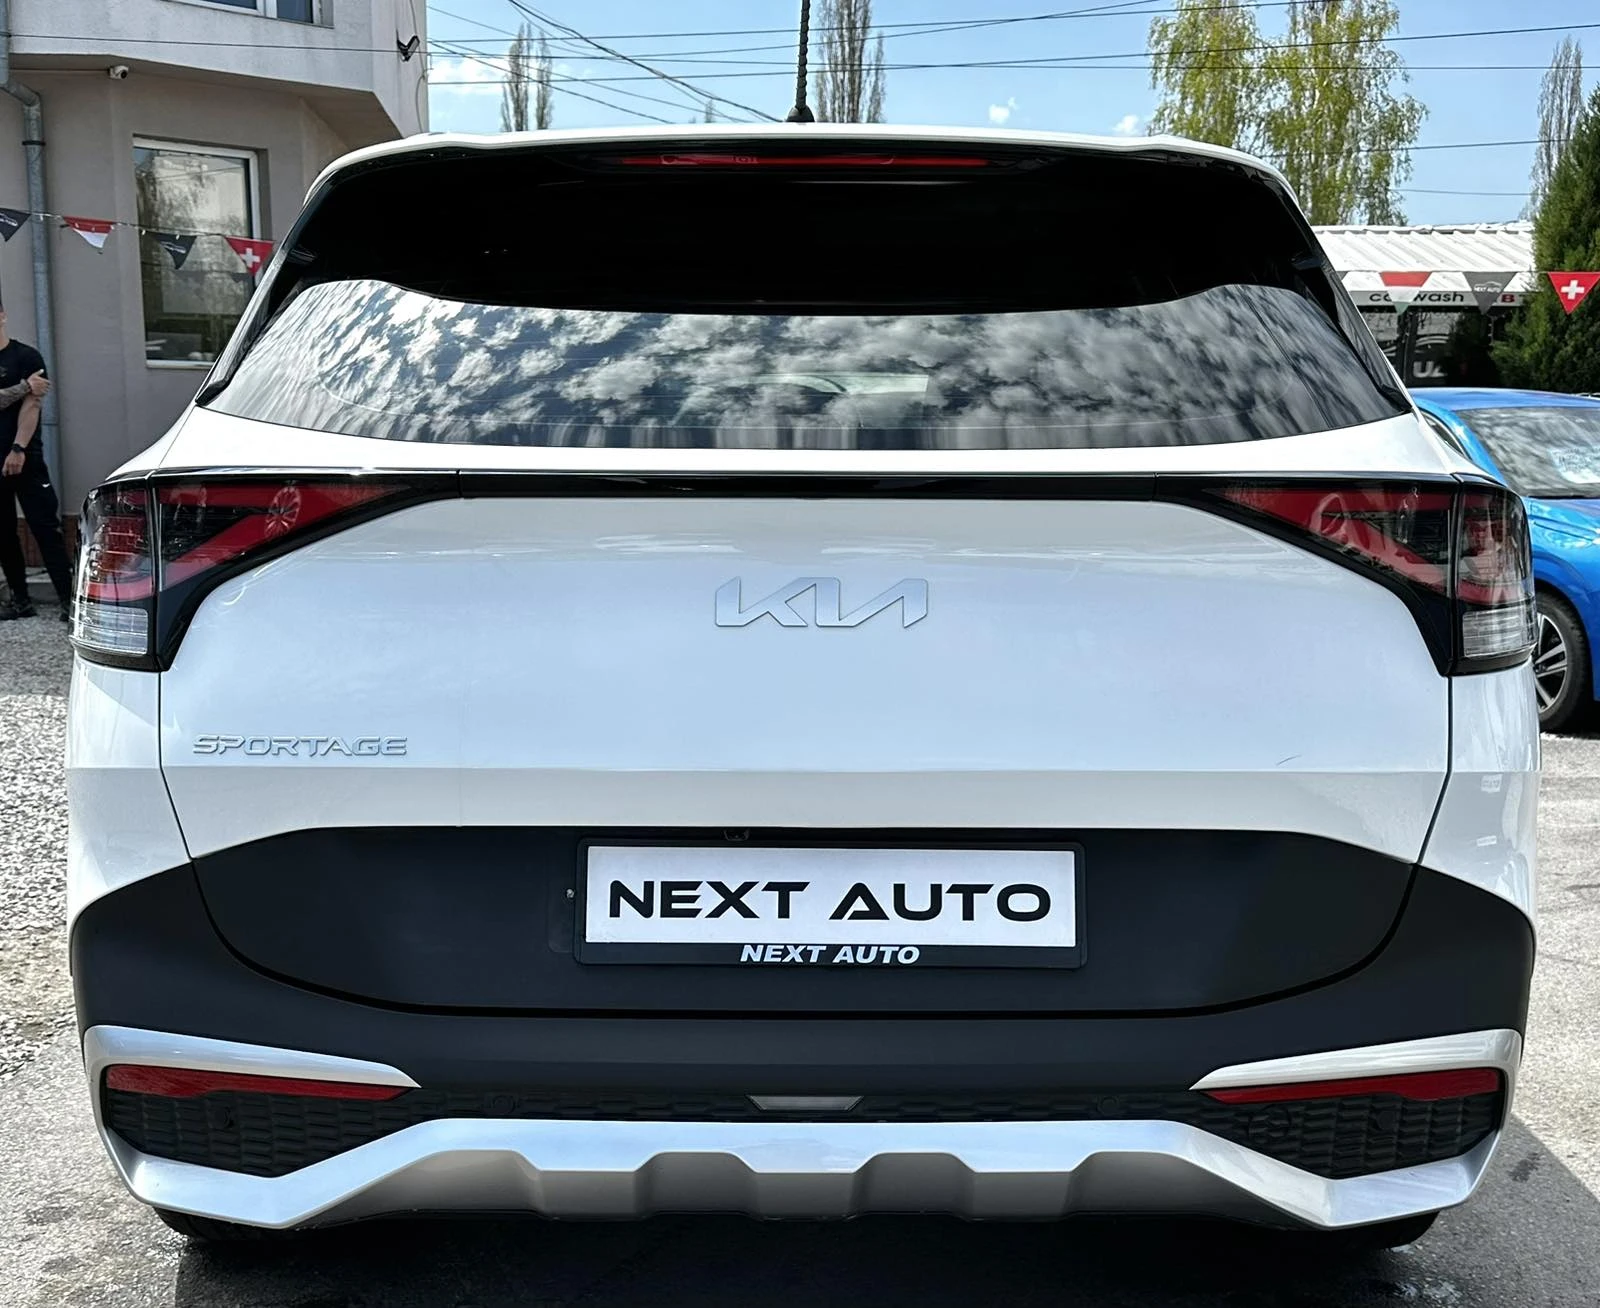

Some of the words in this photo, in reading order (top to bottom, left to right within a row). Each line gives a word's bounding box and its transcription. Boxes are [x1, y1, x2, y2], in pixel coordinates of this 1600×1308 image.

[1413, 291, 1464, 303] wash
[715, 576, 928, 628] KIA
[192, 734, 408, 757] SPORTAGE
[608, 879, 810, 920] NEXT
[828, 881, 1052, 922] AUTO
[740, 944, 827, 963] NEXT
[832, 945, 921, 965] AUTO
